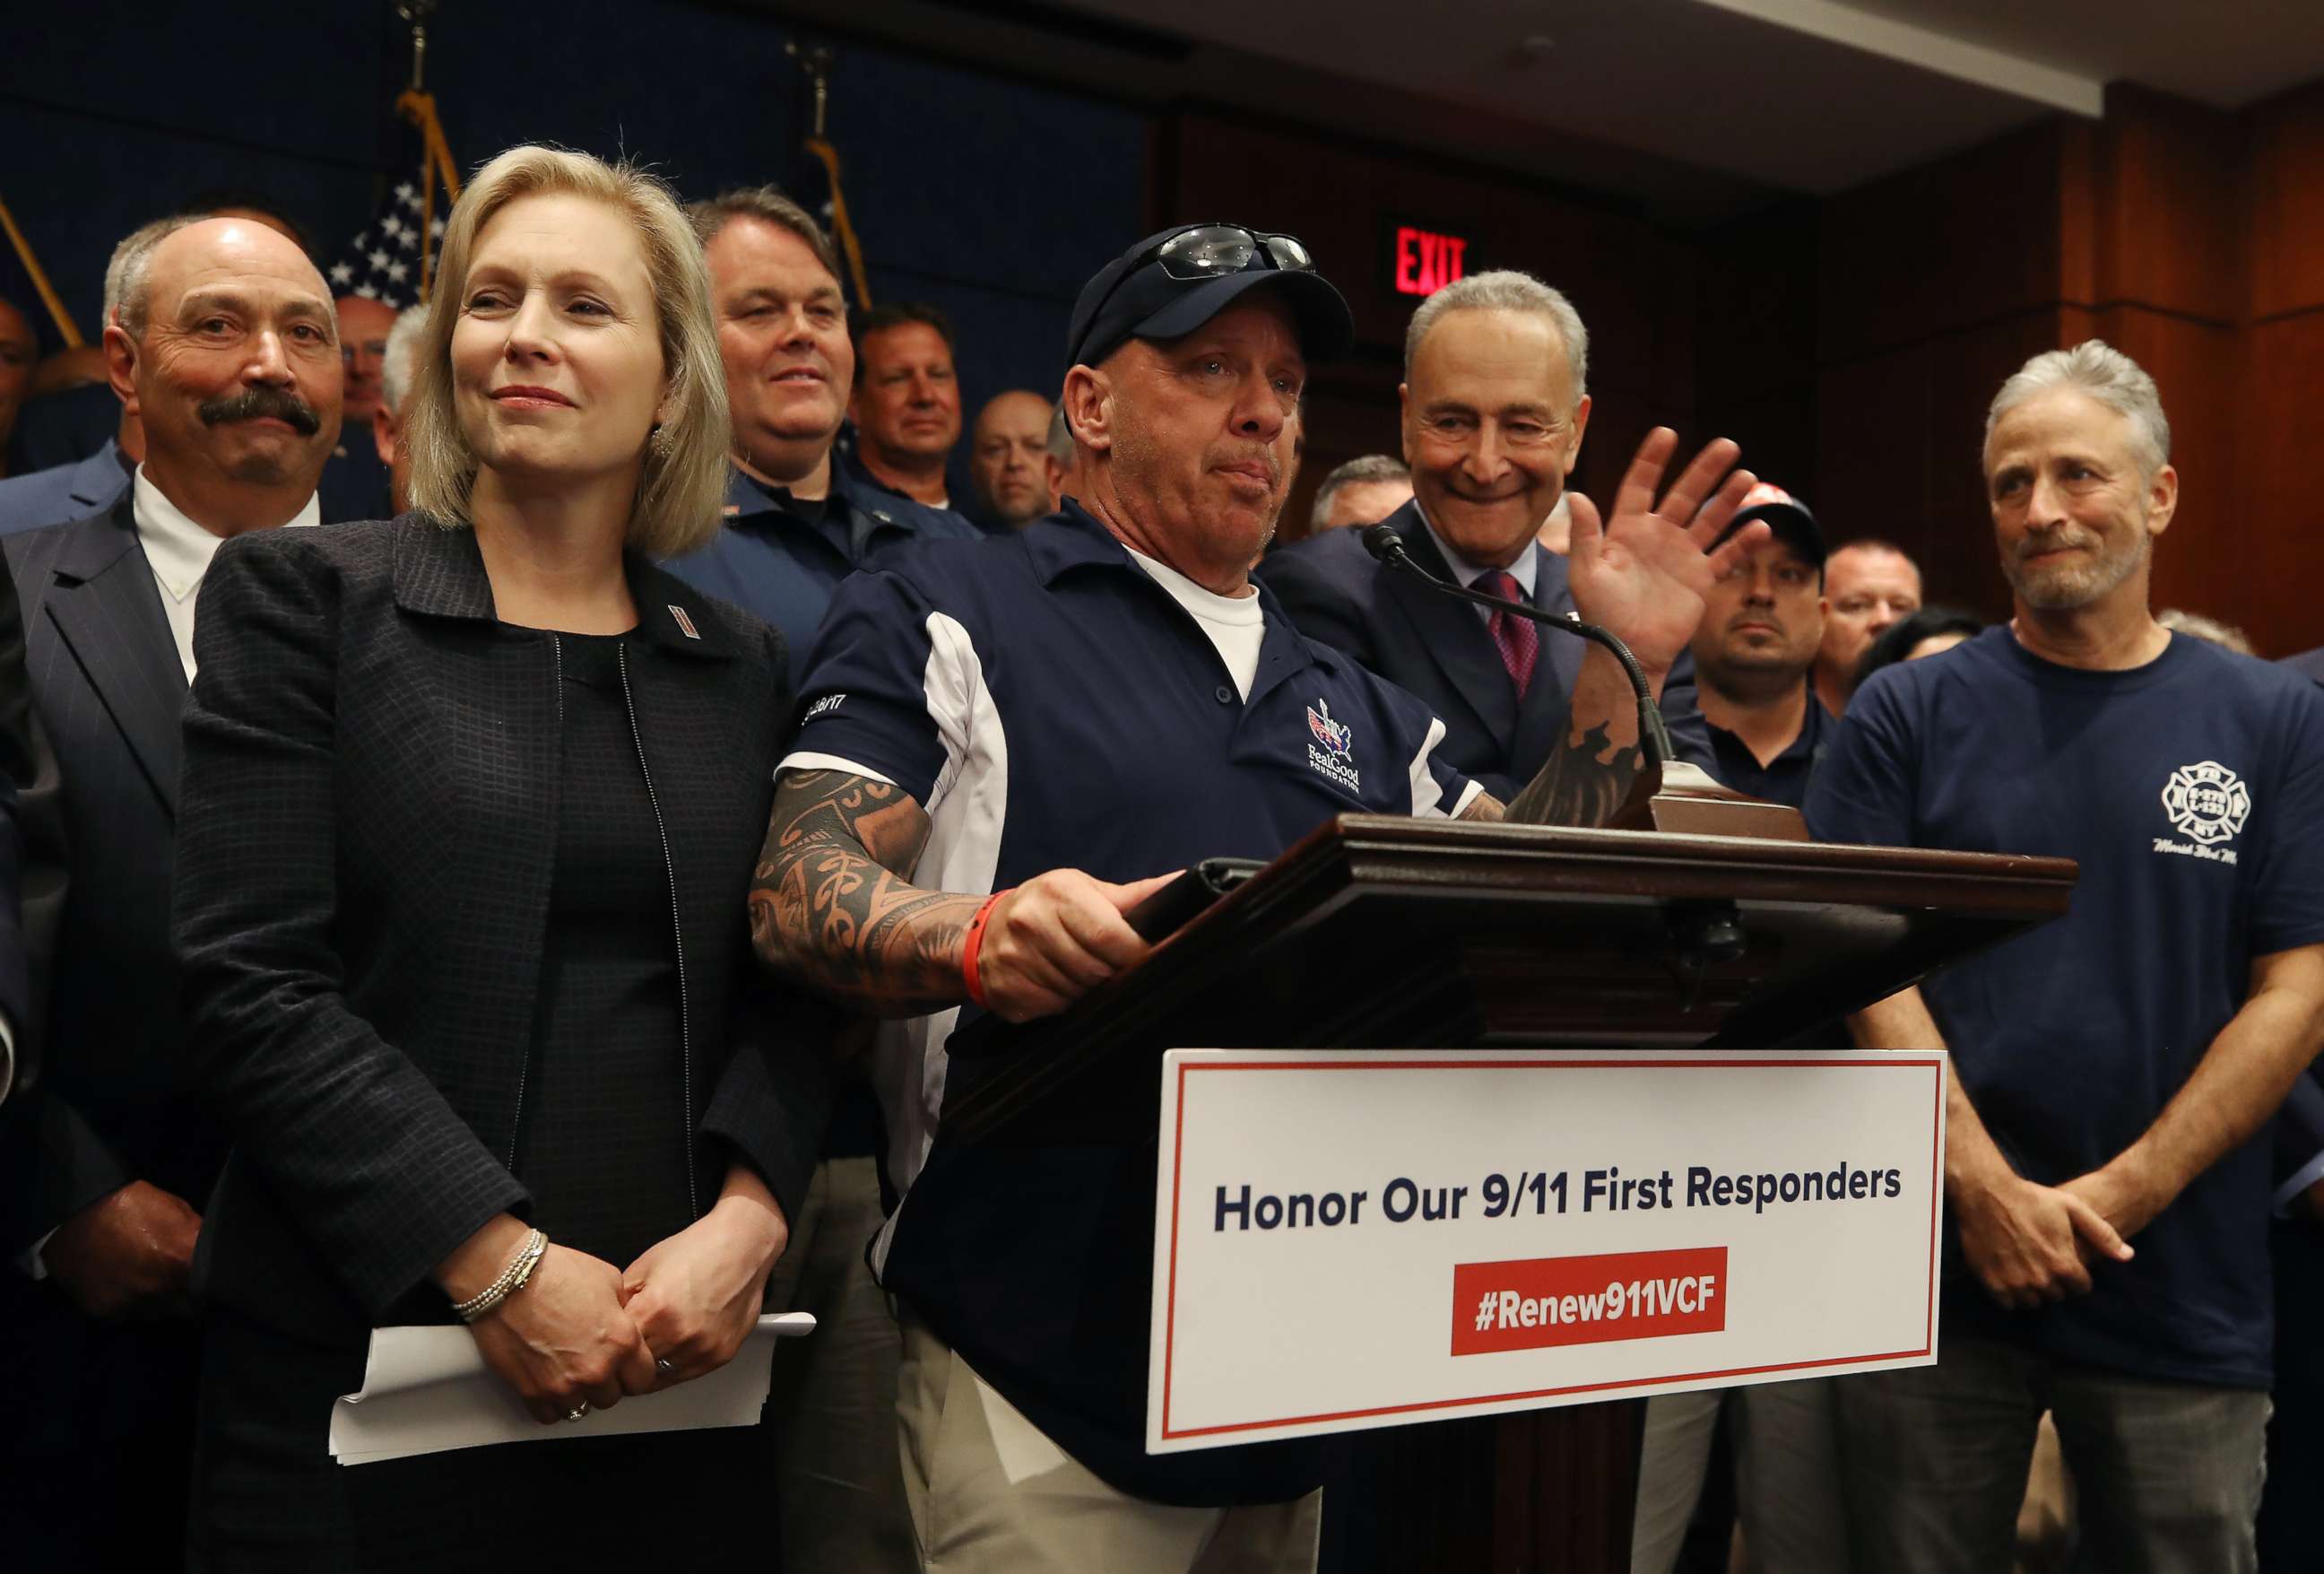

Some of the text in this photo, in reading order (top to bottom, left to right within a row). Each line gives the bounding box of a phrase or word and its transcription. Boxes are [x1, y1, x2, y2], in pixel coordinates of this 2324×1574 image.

[1396, 226, 1468, 296] EXIT
[1309, 760, 1360, 795] FOUNDATION
[1214, 1161, 1902, 1232] Honor Our 9/11 First Responders
[1475, 1275, 1715, 1332] #Renew911VCF
